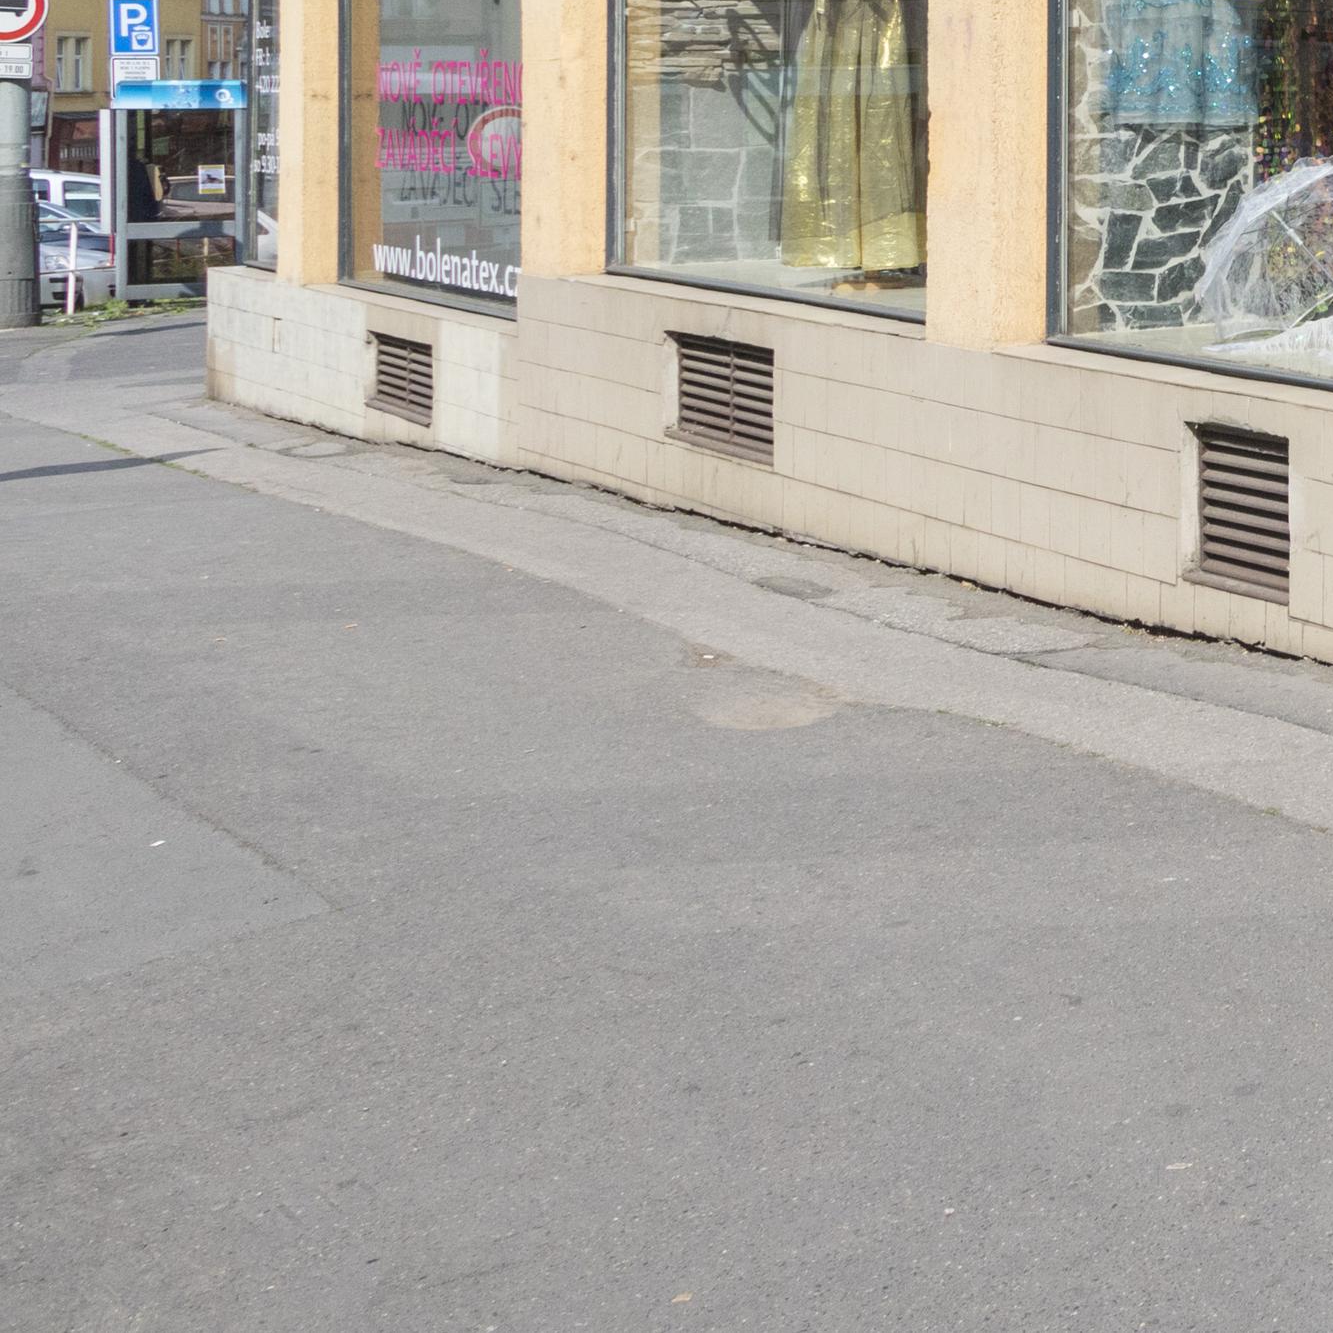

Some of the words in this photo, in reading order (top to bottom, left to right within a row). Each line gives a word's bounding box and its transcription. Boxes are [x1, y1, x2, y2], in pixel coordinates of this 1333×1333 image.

[120, 3, 148, 37] P
[376, 48, 422, 104] NOVĚ
[375, 117, 456, 173] ZAVÁDĚCÍ
[467, 131, 522, 182] SLEVY
